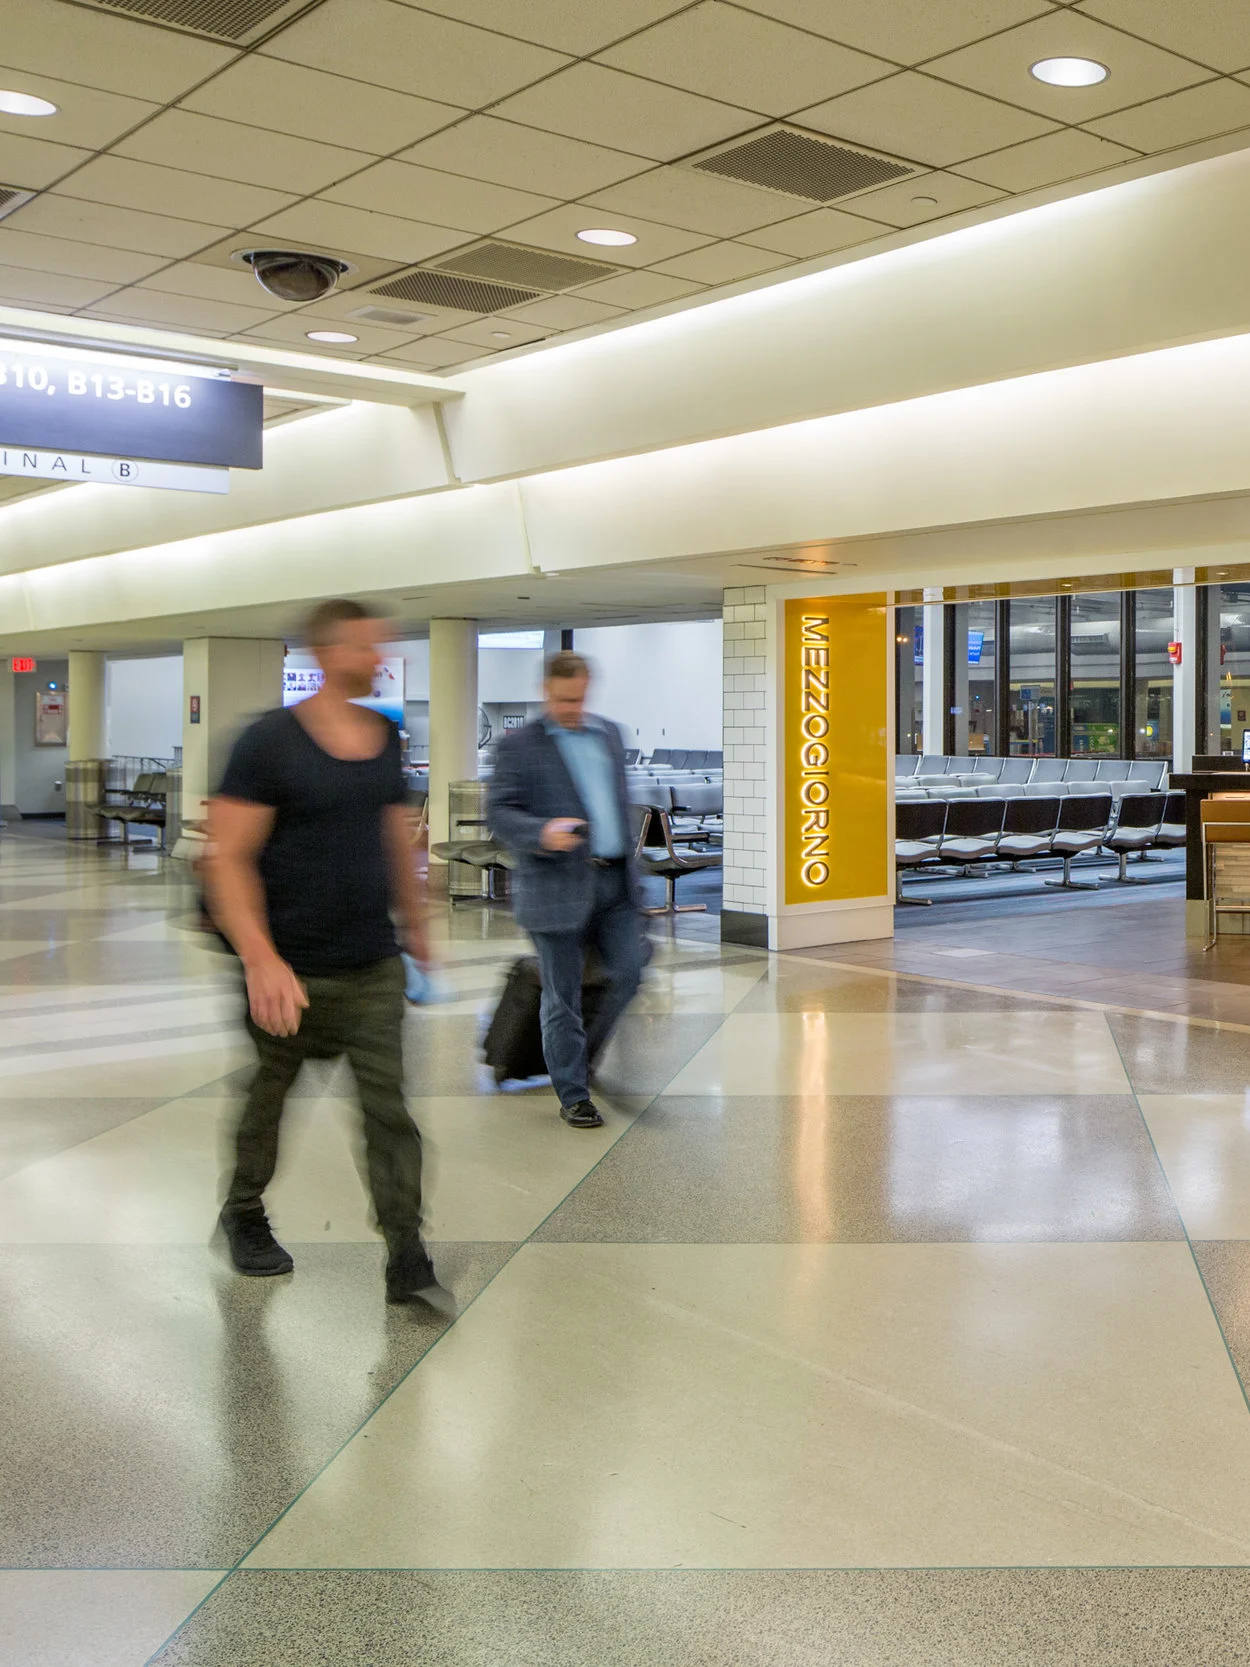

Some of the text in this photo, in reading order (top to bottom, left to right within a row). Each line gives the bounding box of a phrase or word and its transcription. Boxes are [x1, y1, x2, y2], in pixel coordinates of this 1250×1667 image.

[67, 369, 192, 408] B13-B16
[119, 462, 131, 477] B
[802, 616, 830, 887] MEZZOGIORNO
